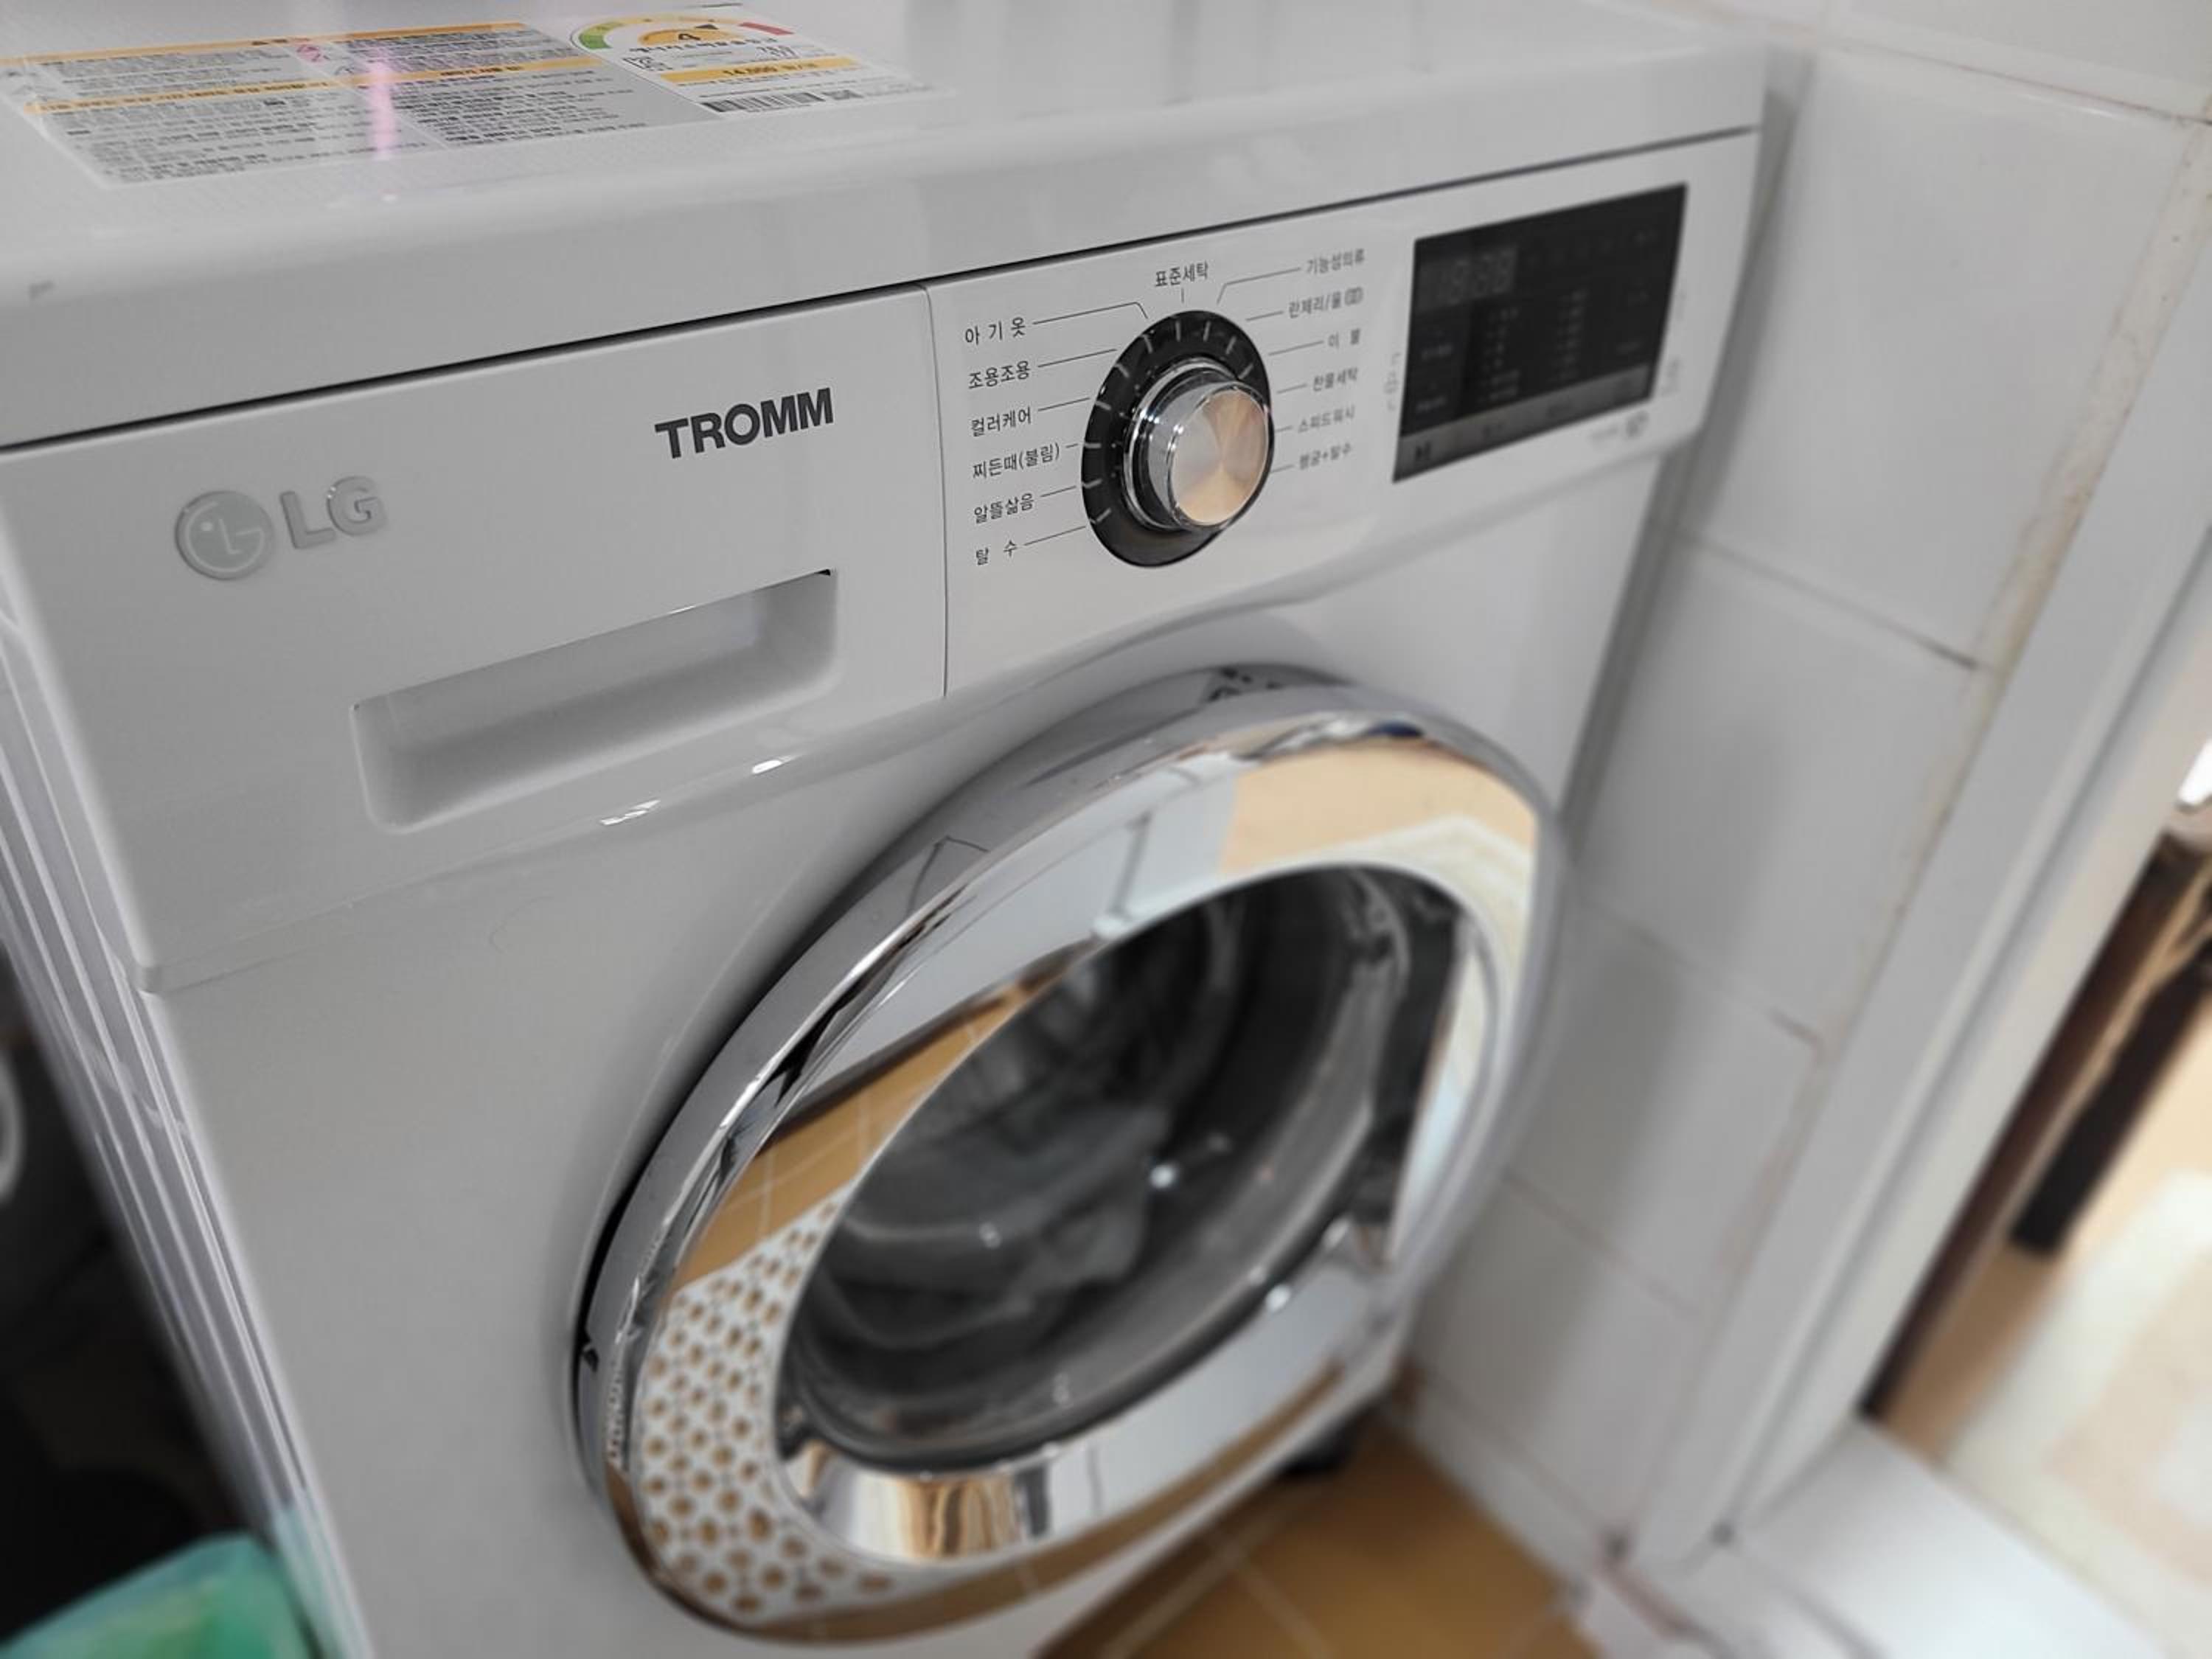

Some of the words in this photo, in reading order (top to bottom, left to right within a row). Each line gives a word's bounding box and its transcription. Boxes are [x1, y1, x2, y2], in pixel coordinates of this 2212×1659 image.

[1155, 261, 1209, 287] 표준세탁
[1307, 248, 1366, 276] 기능성의류
[968, 361, 1031, 389] 조용조용
[654, 387, 835, 459] TROMM
[971, 406, 1032, 437] 컬러케어
[973, 442, 1060, 479] 찌든때(불림)
[281, 475, 386, 551] LG
[974, 493, 1034, 524] 알뜰삶음
